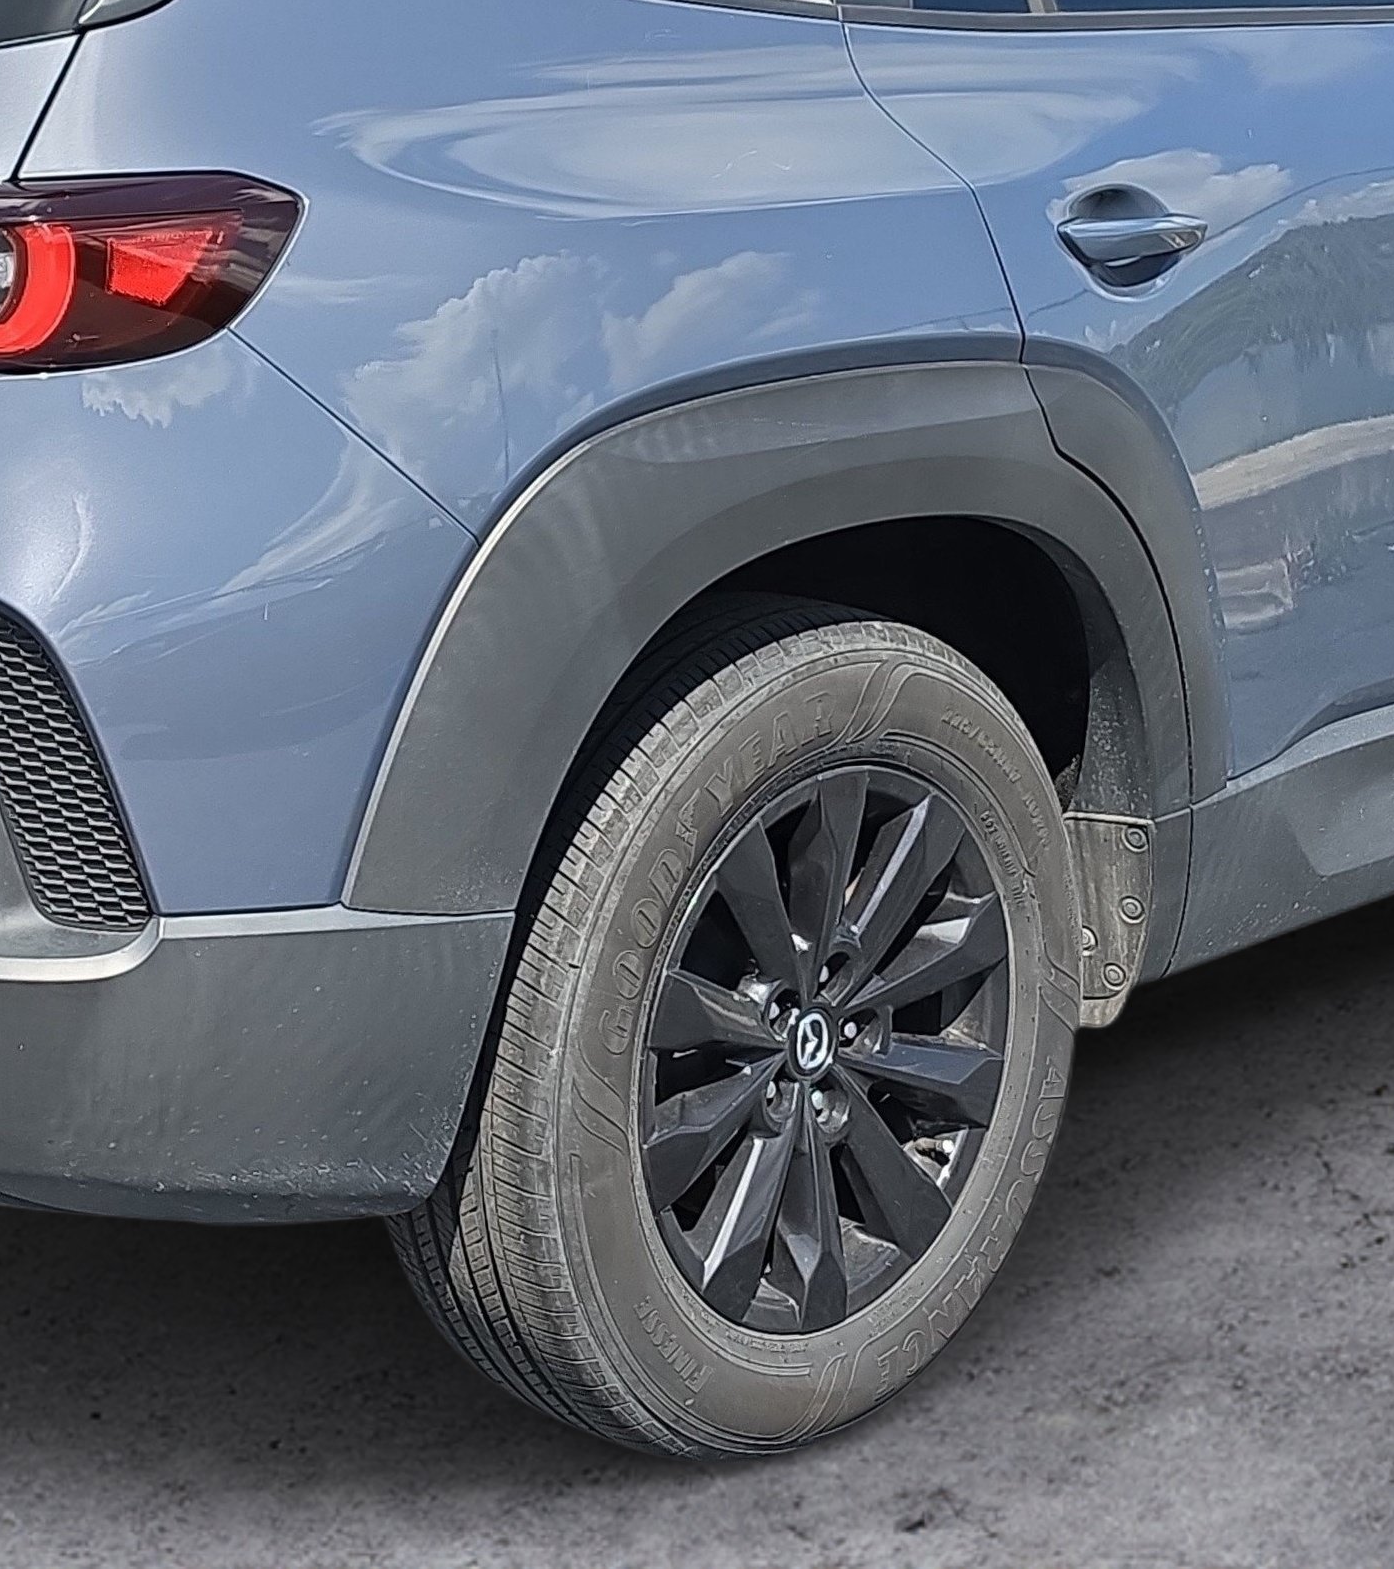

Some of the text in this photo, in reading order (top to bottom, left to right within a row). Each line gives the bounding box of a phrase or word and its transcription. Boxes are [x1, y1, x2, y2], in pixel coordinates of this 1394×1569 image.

[598, 690, 835, 1056] GOODYEAR
[632, 1294, 715, 1394] FINESSE
[873, 1056, 1065, 1403] ASSURANCE
